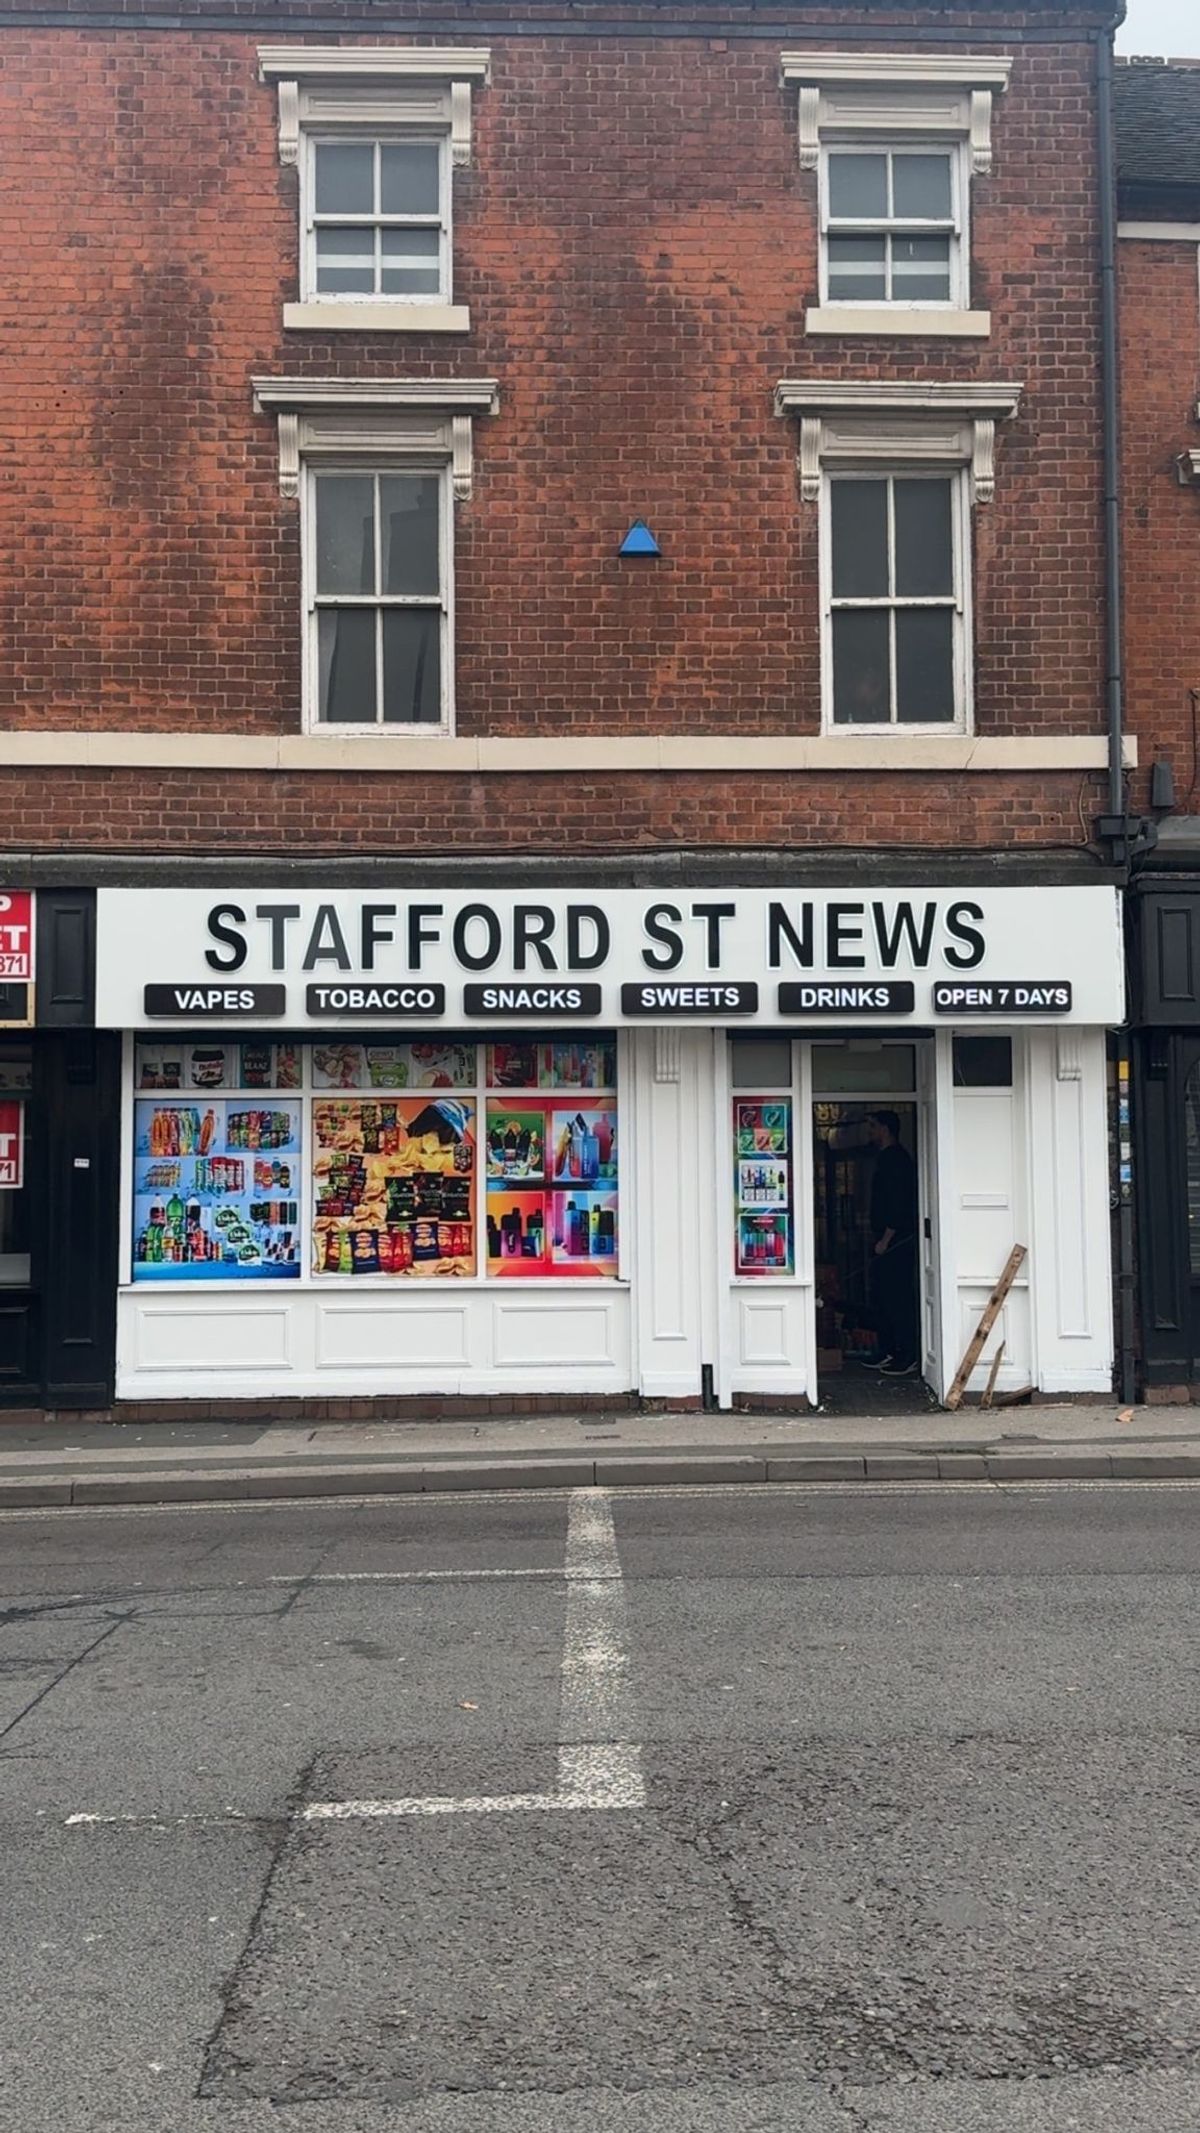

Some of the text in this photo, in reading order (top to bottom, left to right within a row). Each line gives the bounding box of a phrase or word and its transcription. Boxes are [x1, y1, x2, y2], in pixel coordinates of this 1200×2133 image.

[204, 901, 986, 972] STAFFORD ST NEWS
[174, 990, 255, 1010] VAPES
[315, 988, 436, 1009] TOBACCO
[482, 988, 582, 1009] SNACKS
[641, 987, 740, 1007] SWEETS
[801, 987, 890, 1007] DRINKS
[936, 988, 1069, 1005] OPEN 7 DAYS
